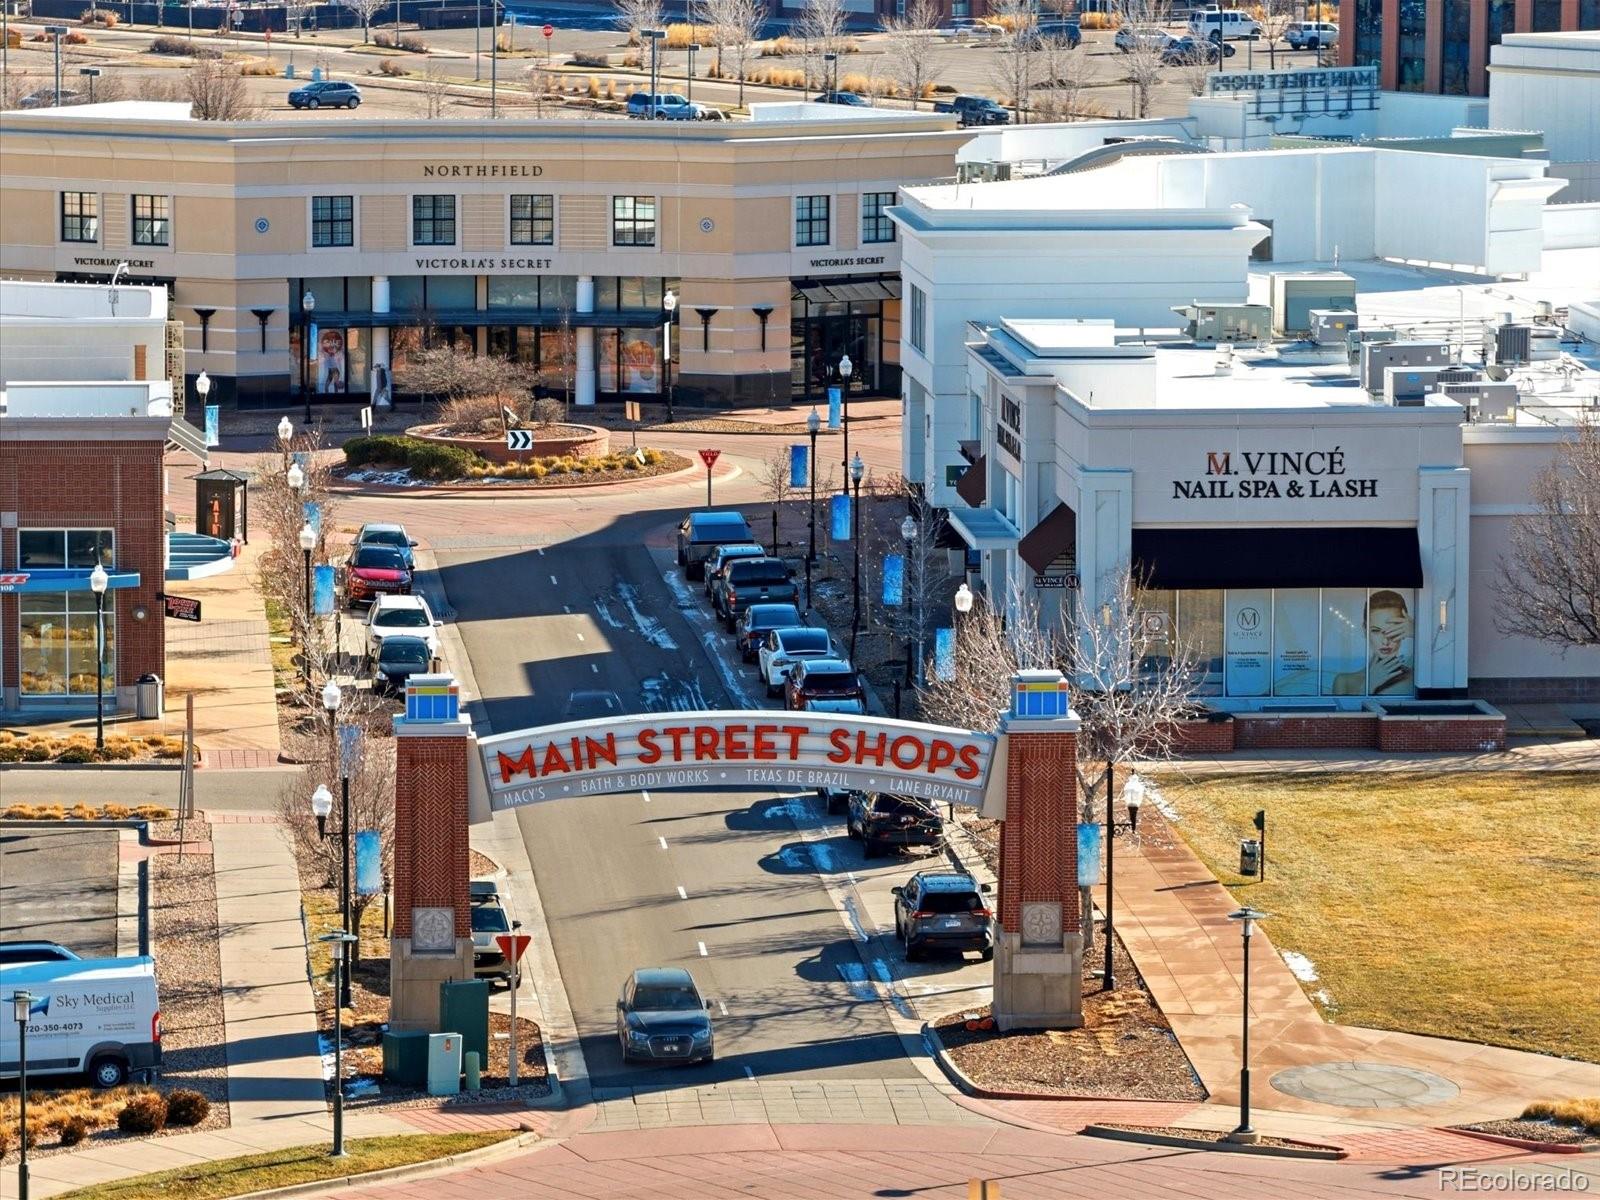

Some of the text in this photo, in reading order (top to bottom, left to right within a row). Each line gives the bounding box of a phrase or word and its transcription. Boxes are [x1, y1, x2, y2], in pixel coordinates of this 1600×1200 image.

[424, 165, 543, 176] NORTHFIELD
[74, 257, 120, 266] VICTORIA'S
[416, 258, 552, 269] VICTORIA'S SECRET
[810, 256, 885, 267] VICTORIA'S SECRET
[1172, 479, 1378, 499] NAIL SPA & LASH
[497, 725, 981, 784] MAIN STREET SHOPS
[504, 769, 971, 806] MACY'S BATH & BODY WORKS TEXAS DE BRAZIL LANE BRYANT
[56, 991, 135, 1009] Sky Medical
[25, 1022, 83, 1033] 720-350-4073
